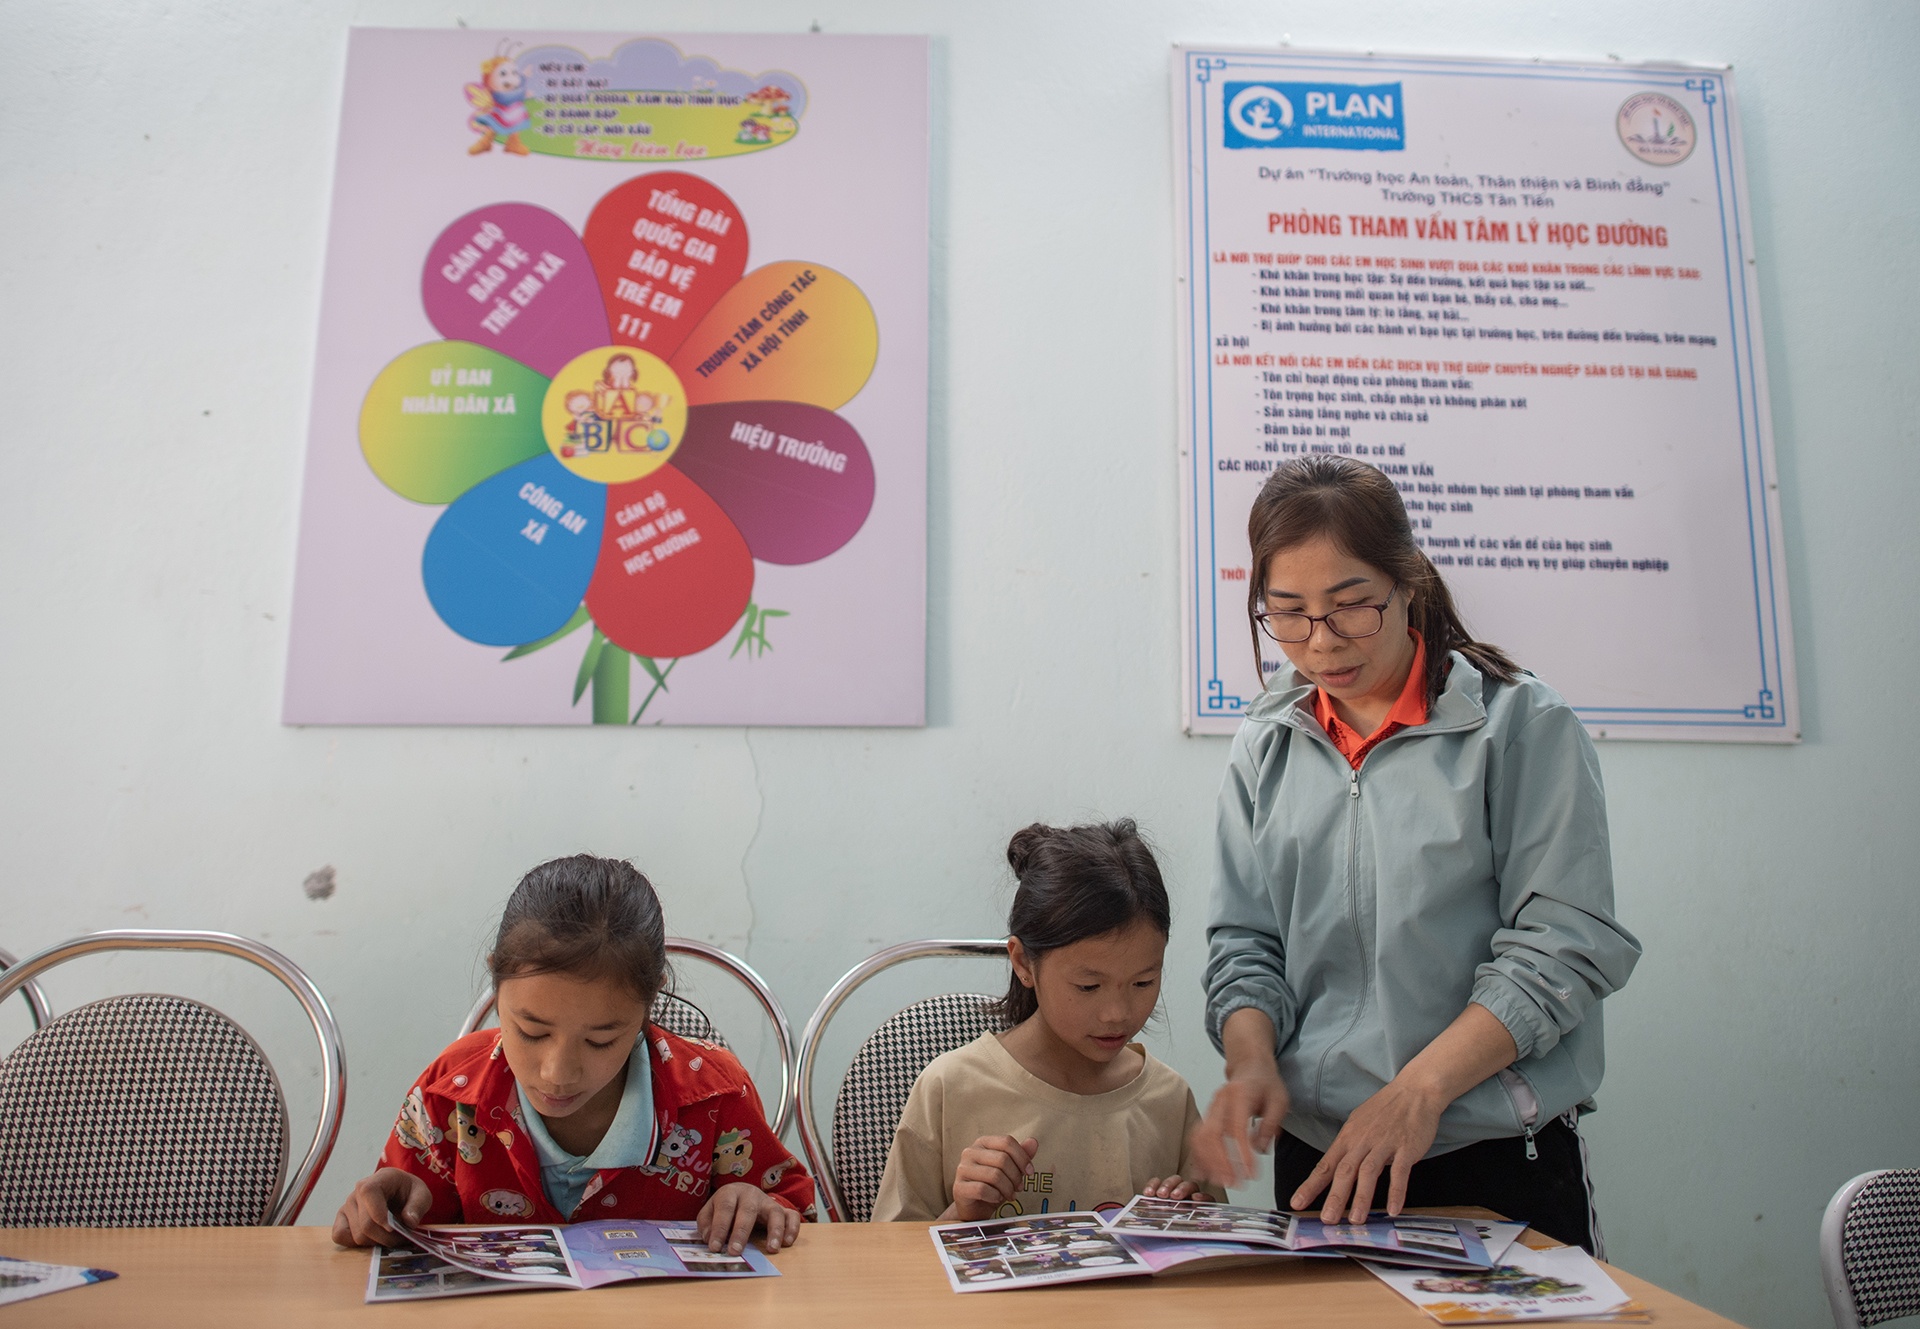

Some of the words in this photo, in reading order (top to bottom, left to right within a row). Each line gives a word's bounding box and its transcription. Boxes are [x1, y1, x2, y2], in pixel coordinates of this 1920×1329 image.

[1305, 91, 1394, 119] PLAN
[1302, 124, 1400, 140] INTERNATIONAL
[1257, 167, 1281, 182] Dự
[1285, 167, 1304, 180] án
[1376, 170, 1403, 186] học
[1409, 171, 1430, 184] An
[1479, 174, 1516, 187] Thân
[1520, 175, 1559, 191] thiện
[1564, 176, 1582, 189] và
[1586, 177, 1621, 190] Bình
[1380, 189, 1436, 206] Trường
[1441, 191, 1483, 205] THCS
[1489, 193, 1517, 206] Tân
[1523, 193, 1555, 208] Tiến
[647, 188, 698, 224] TỔNG
[694, 207, 733, 237] ĐÀI
[1267, 209, 1342, 235] PHÒNG
[1349, 217, 1409, 237] THAM
[1414, 215, 1458, 239] VẤN
[1464, 216, 1510, 241] TÂM
[1516, 218, 1540, 242] LÝ
[1546, 224, 1590, 248] HỌC
[1595, 221, 1669, 247] ĐƯỜNG
[440, 242, 484, 284] CÁN
[472, 220, 506, 252] BỘ
[632, 217, 686, 252] QUỐC
[682, 236, 718, 266] GIA
[466, 264, 508, 305] BẢO
[497, 241, 531, 271] VỆ
[627, 248, 670, 280] BẢO
[668, 264, 698, 293] VỆ
[480, 295, 521, 335] TRẺ
[508, 273, 546, 308] EM
[532, 249, 568, 283] XÃ
[614, 276, 654, 307] TRẺ
[648, 291, 685, 320] EM
[617, 313, 653, 342] 111
[695, 340, 738, 378] TRUNG
[733, 317, 764, 344] TÂM
[759, 289, 796, 322] CÔNG
[789, 269, 817, 294] TÁC
[740, 351, 763, 373] XÃ
[757, 333, 783, 357] HỘI
[777, 309, 809, 337] TỈNH
[456, 368, 493, 387] BAN
[402, 392, 450, 415] NHÂN
[453, 392, 490, 415] DÂN
[492, 392, 517, 415] XÃ
[605, 390, 632, 416] A
[730, 420, 776, 451] HIỆU
[776, 434, 848, 474] TRƯỞNG
[1218, 457, 1241, 472] CÁC
[1244, 459, 1273, 474] HOẠT
[1412, 461, 1434, 477] VẤN
[518, 482, 564, 520] CÔNG
[558, 509, 588, 536] AN
[615, 503, 647, 528] CÁN
[644, 489, 668, 514] BỘ
[519, 518, 550, 546] XÃ
[616, 521, 658, 552] THAM
[654, 507, 687, 533] VẤN
[623, 550, 655, 576] HỌC
[652, 527, 702, 562] ĐƯỜNG
[1220, 567, 1246, 581] THỜI
[1023, 1171, 1054, 1194] HE
